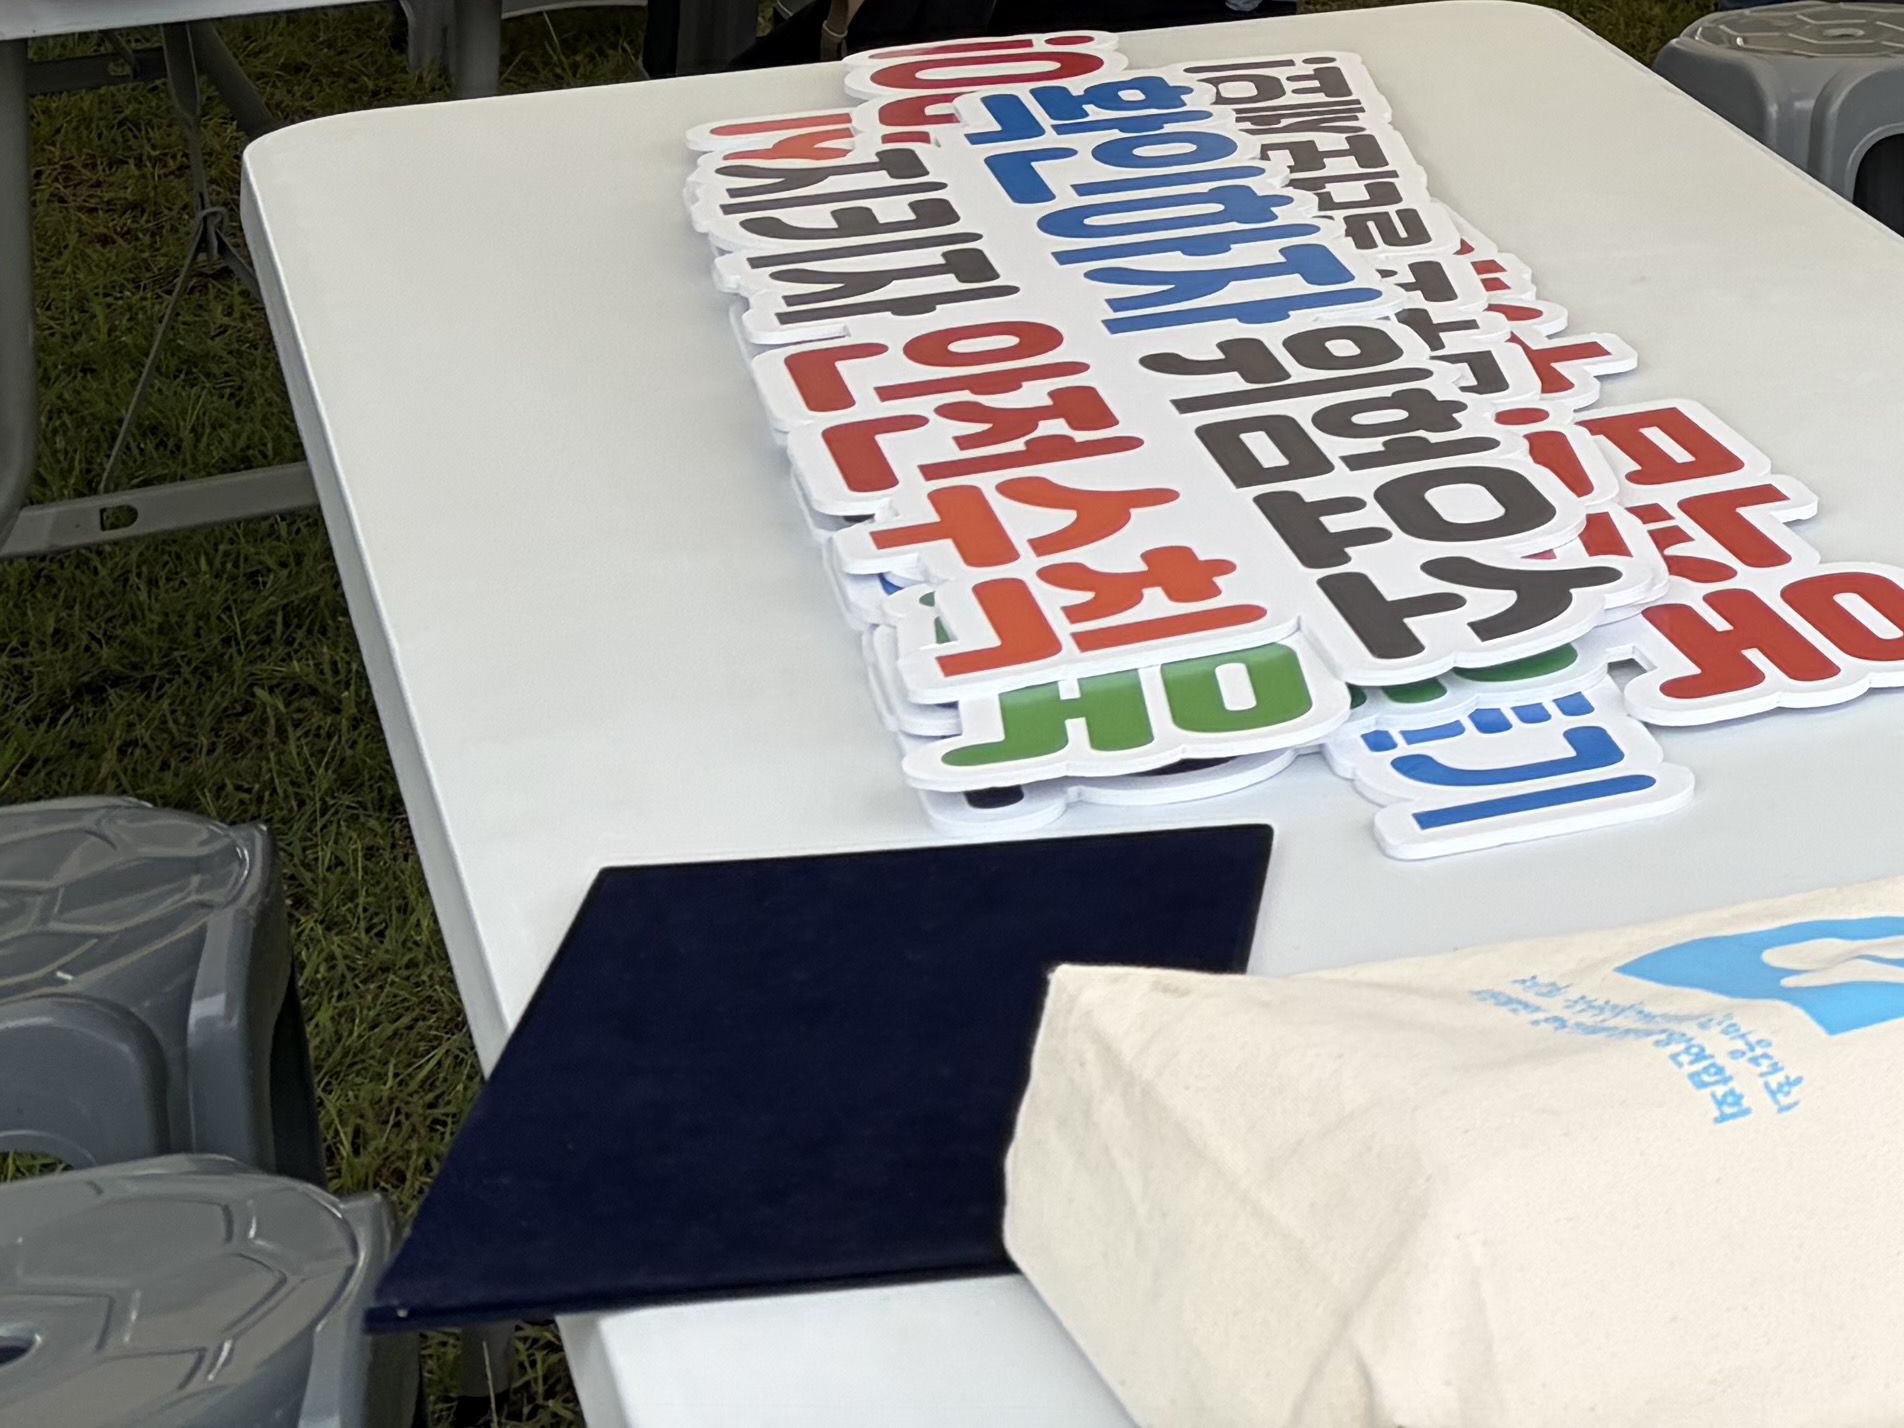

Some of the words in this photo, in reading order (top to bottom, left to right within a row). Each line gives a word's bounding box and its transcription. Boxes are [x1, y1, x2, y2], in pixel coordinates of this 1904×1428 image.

[715, 146, 1020, 326] 지키자
[965, 74, 1382, 335] 확인하자
[785, 320, 1267, 678] 안전수칙
[1137, 320, 1622, 660] 위험요소
